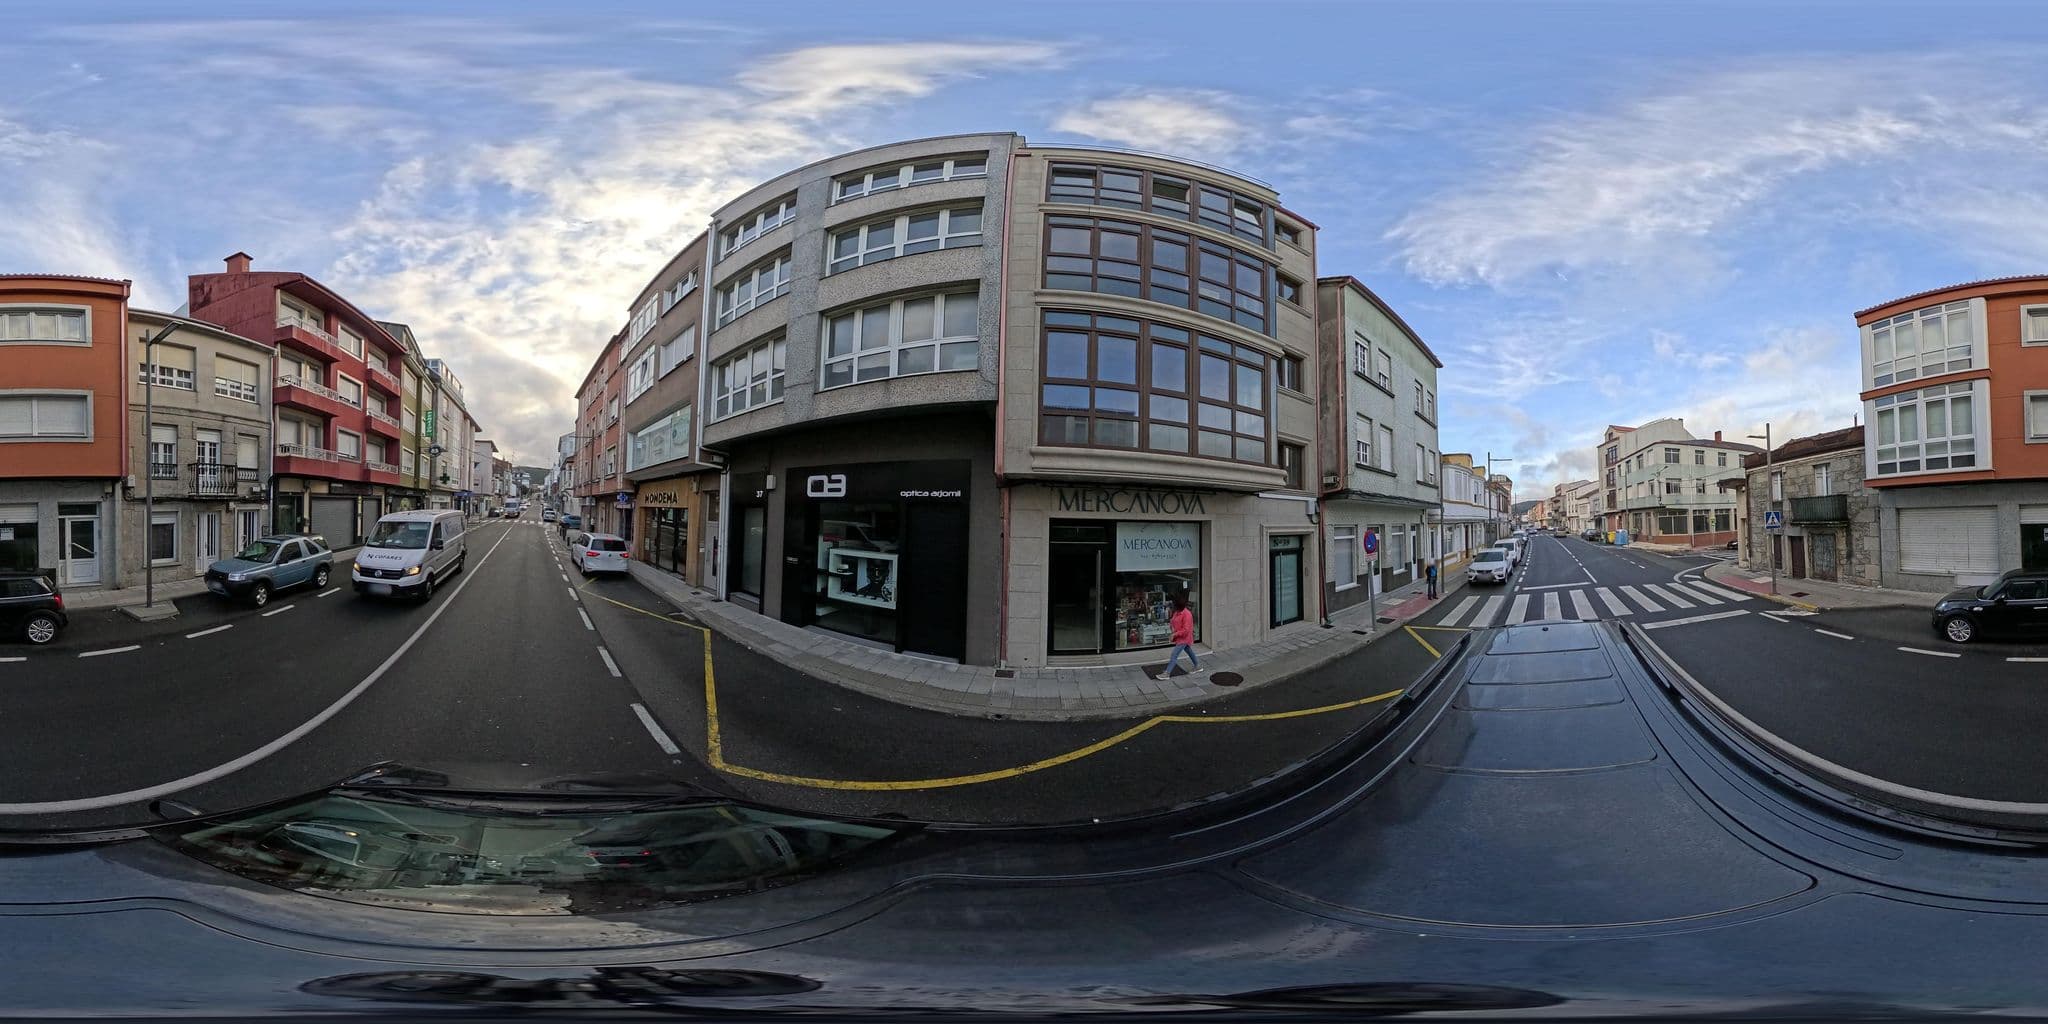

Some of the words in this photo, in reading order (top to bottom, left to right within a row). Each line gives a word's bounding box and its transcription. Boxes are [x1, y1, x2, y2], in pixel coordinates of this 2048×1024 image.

[644, 491, 678, 504] MONDEMA
[1058, 487, 1206, 515] MERCANOVA
[1123, 538, 1193, 551] MERCANOVA
